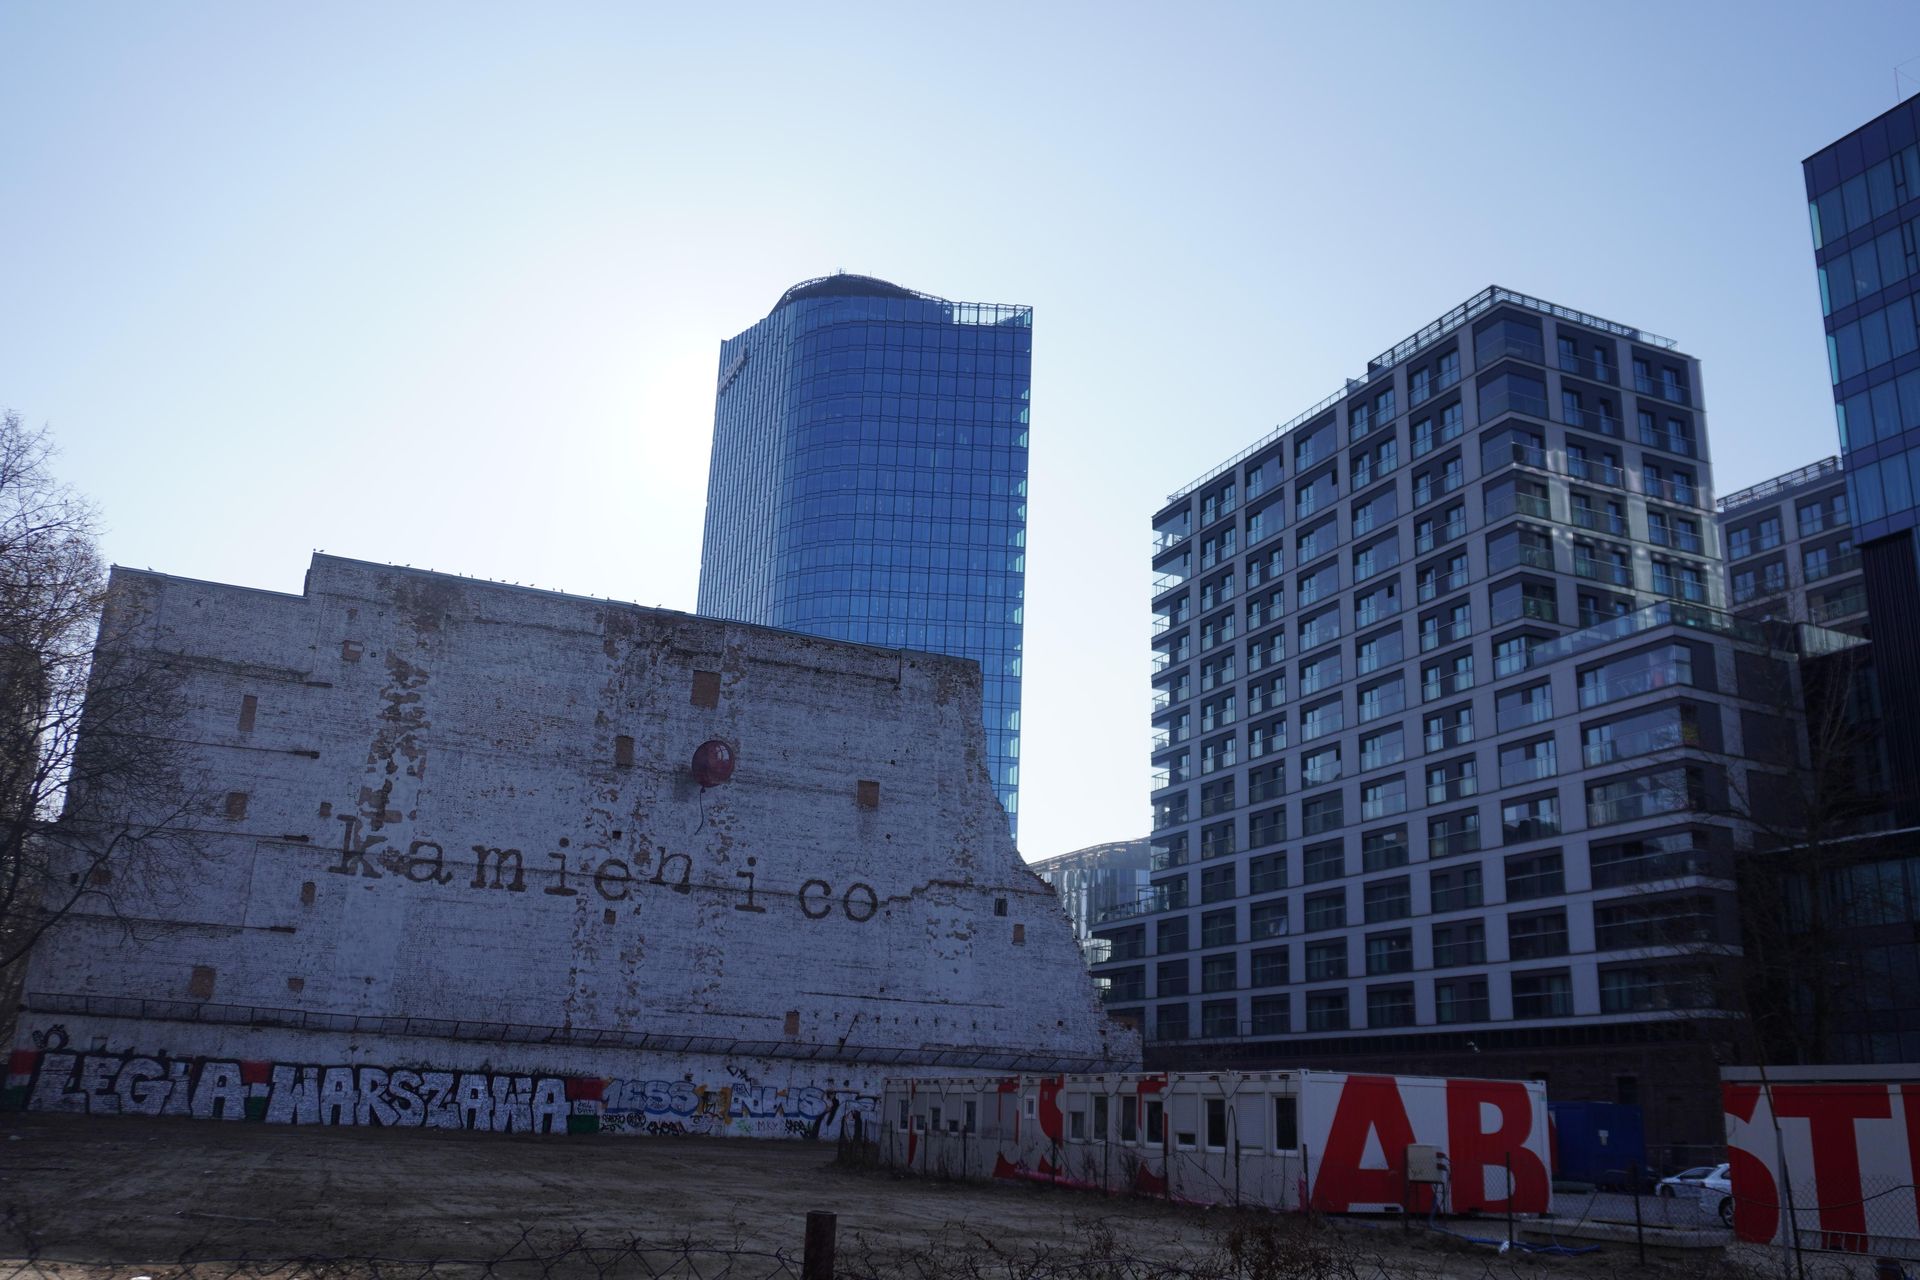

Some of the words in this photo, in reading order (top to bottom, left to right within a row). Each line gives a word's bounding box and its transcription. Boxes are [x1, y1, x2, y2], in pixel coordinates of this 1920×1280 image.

[27, 1050, 249, 1121] LEGIA
[263, 1062, 572, 1136] WARSZAWA
[1311, 1075, 1549, 1214] AB
